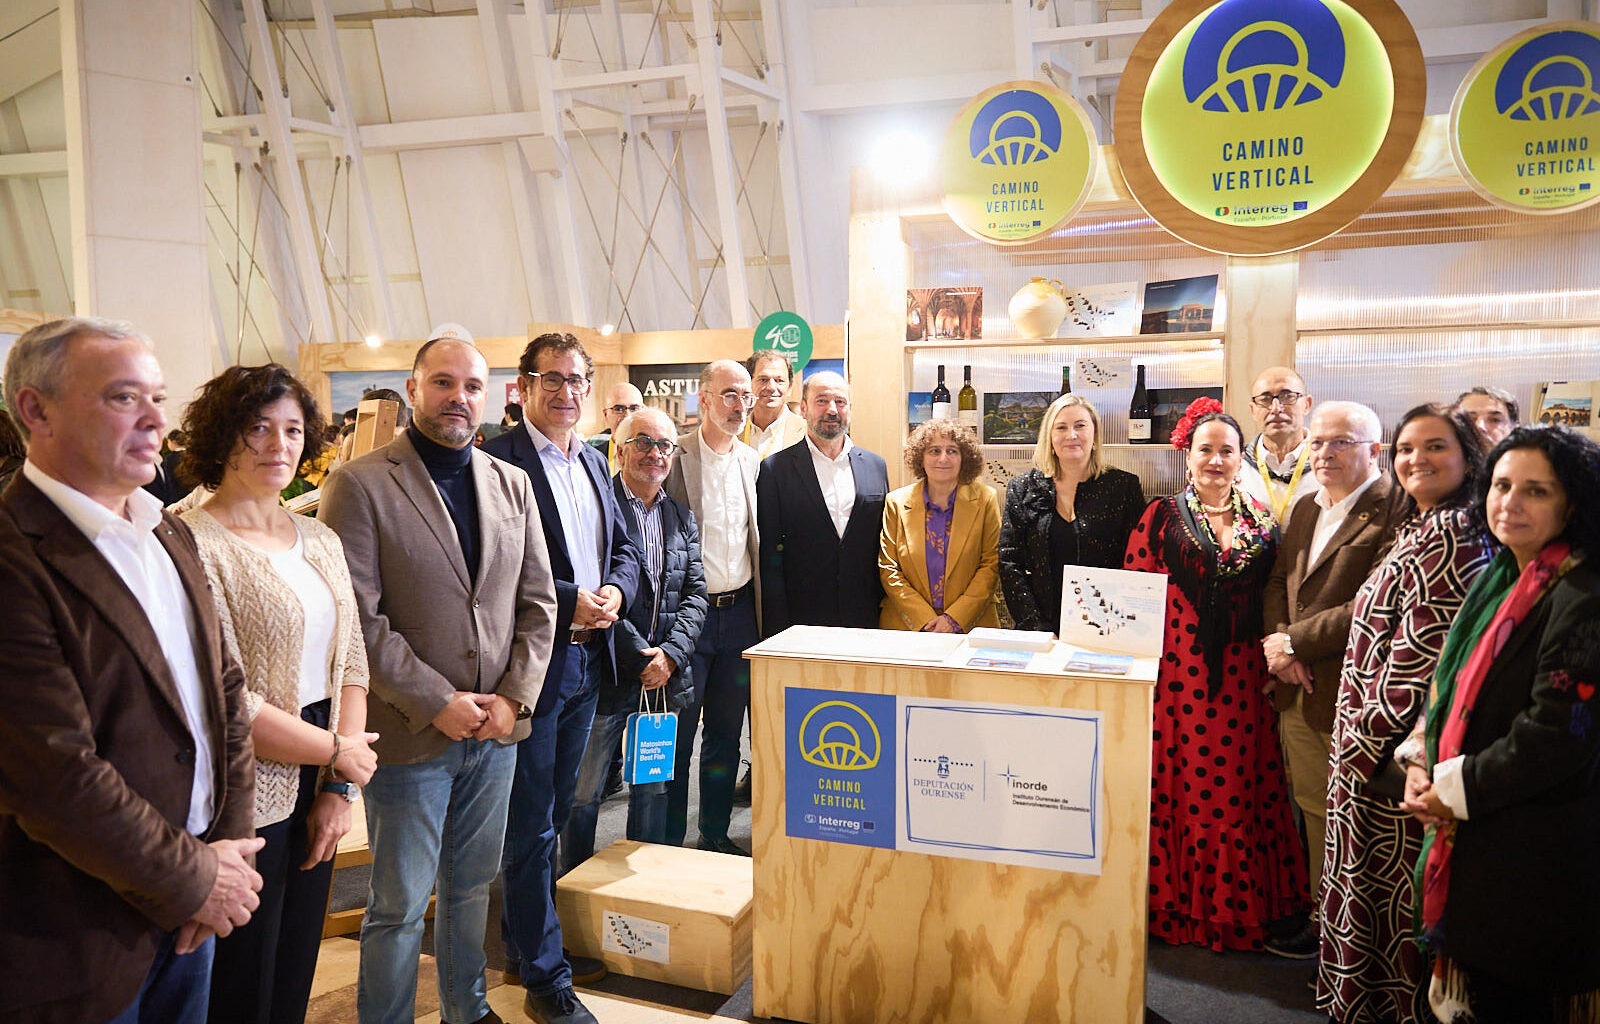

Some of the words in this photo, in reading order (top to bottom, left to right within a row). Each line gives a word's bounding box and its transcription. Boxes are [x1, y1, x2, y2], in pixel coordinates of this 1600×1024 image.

[1222, 136, 1305, 162] CAMINO
[1525, 137, 1588, 156] CAMINO
[1517, 157, 1596, 177] VERTICAL
[1212, 165, 1314, 192] VERTICAL
[992, 180, 1039, 195] CAMINO
[986, 198, 1045, 213] VERTICAL
[1233, 204, 1289, 216] Interreg
[643, 378, 700, 397] ASTU
[818, 778, 861, 794] CAMINO
[913, 778, 974, 792] DEPUTACIÓN
[1012, 779, 1048, 792] inorde
[921, 788, 966, 800] OURENSE
[813, 793, 867, 811] VERTICAL
[818, 815, 860, 830] Interreg
